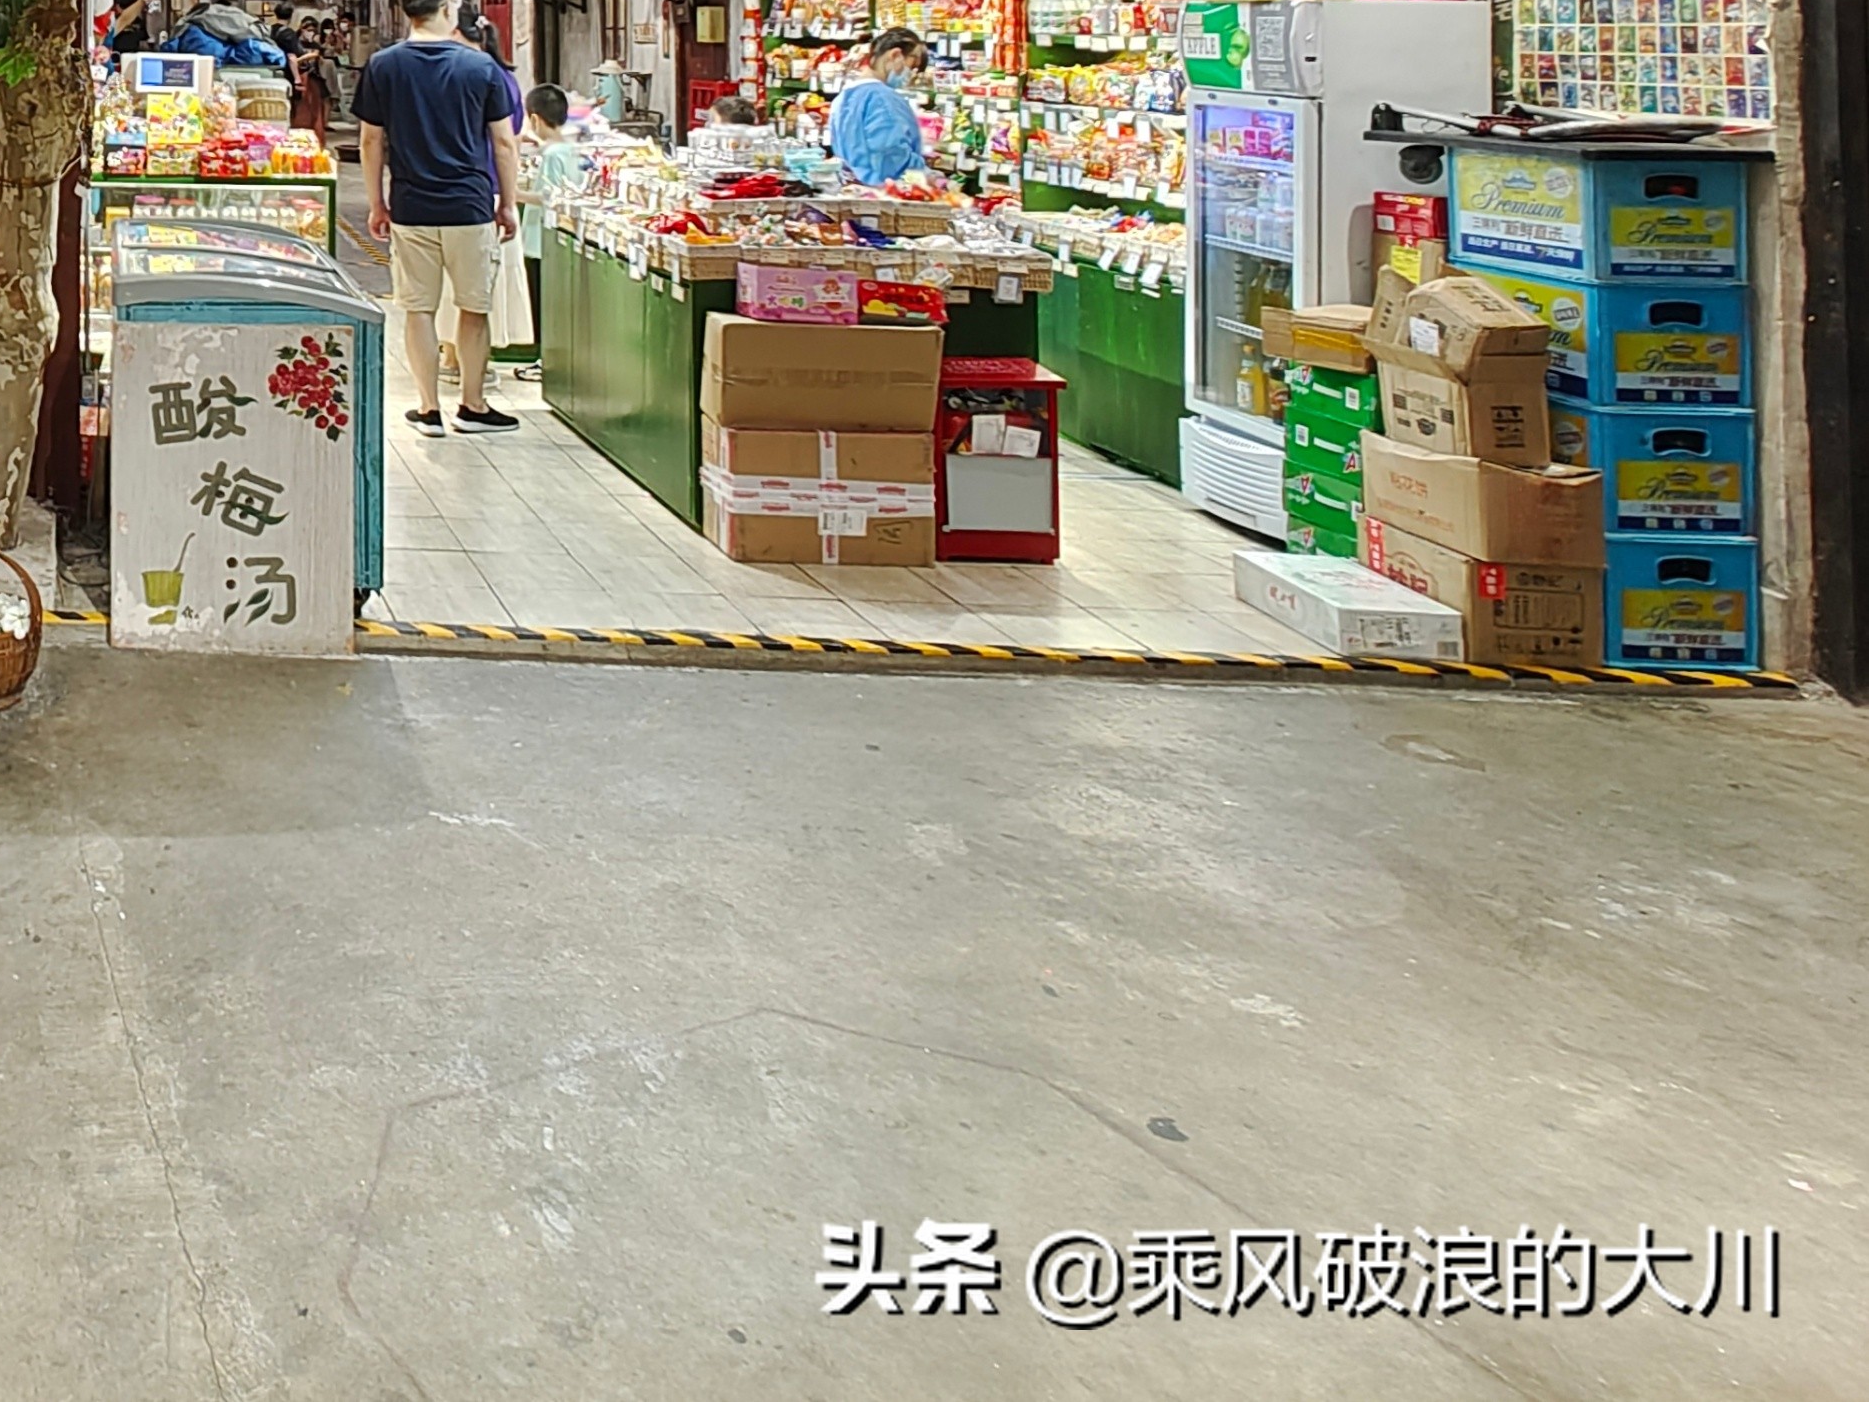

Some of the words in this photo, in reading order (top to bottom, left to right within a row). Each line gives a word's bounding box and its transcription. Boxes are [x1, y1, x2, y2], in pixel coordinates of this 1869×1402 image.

[1471, 182, 1565, 218] Premium
[149, 375, 296, 625] 酸梅汤
